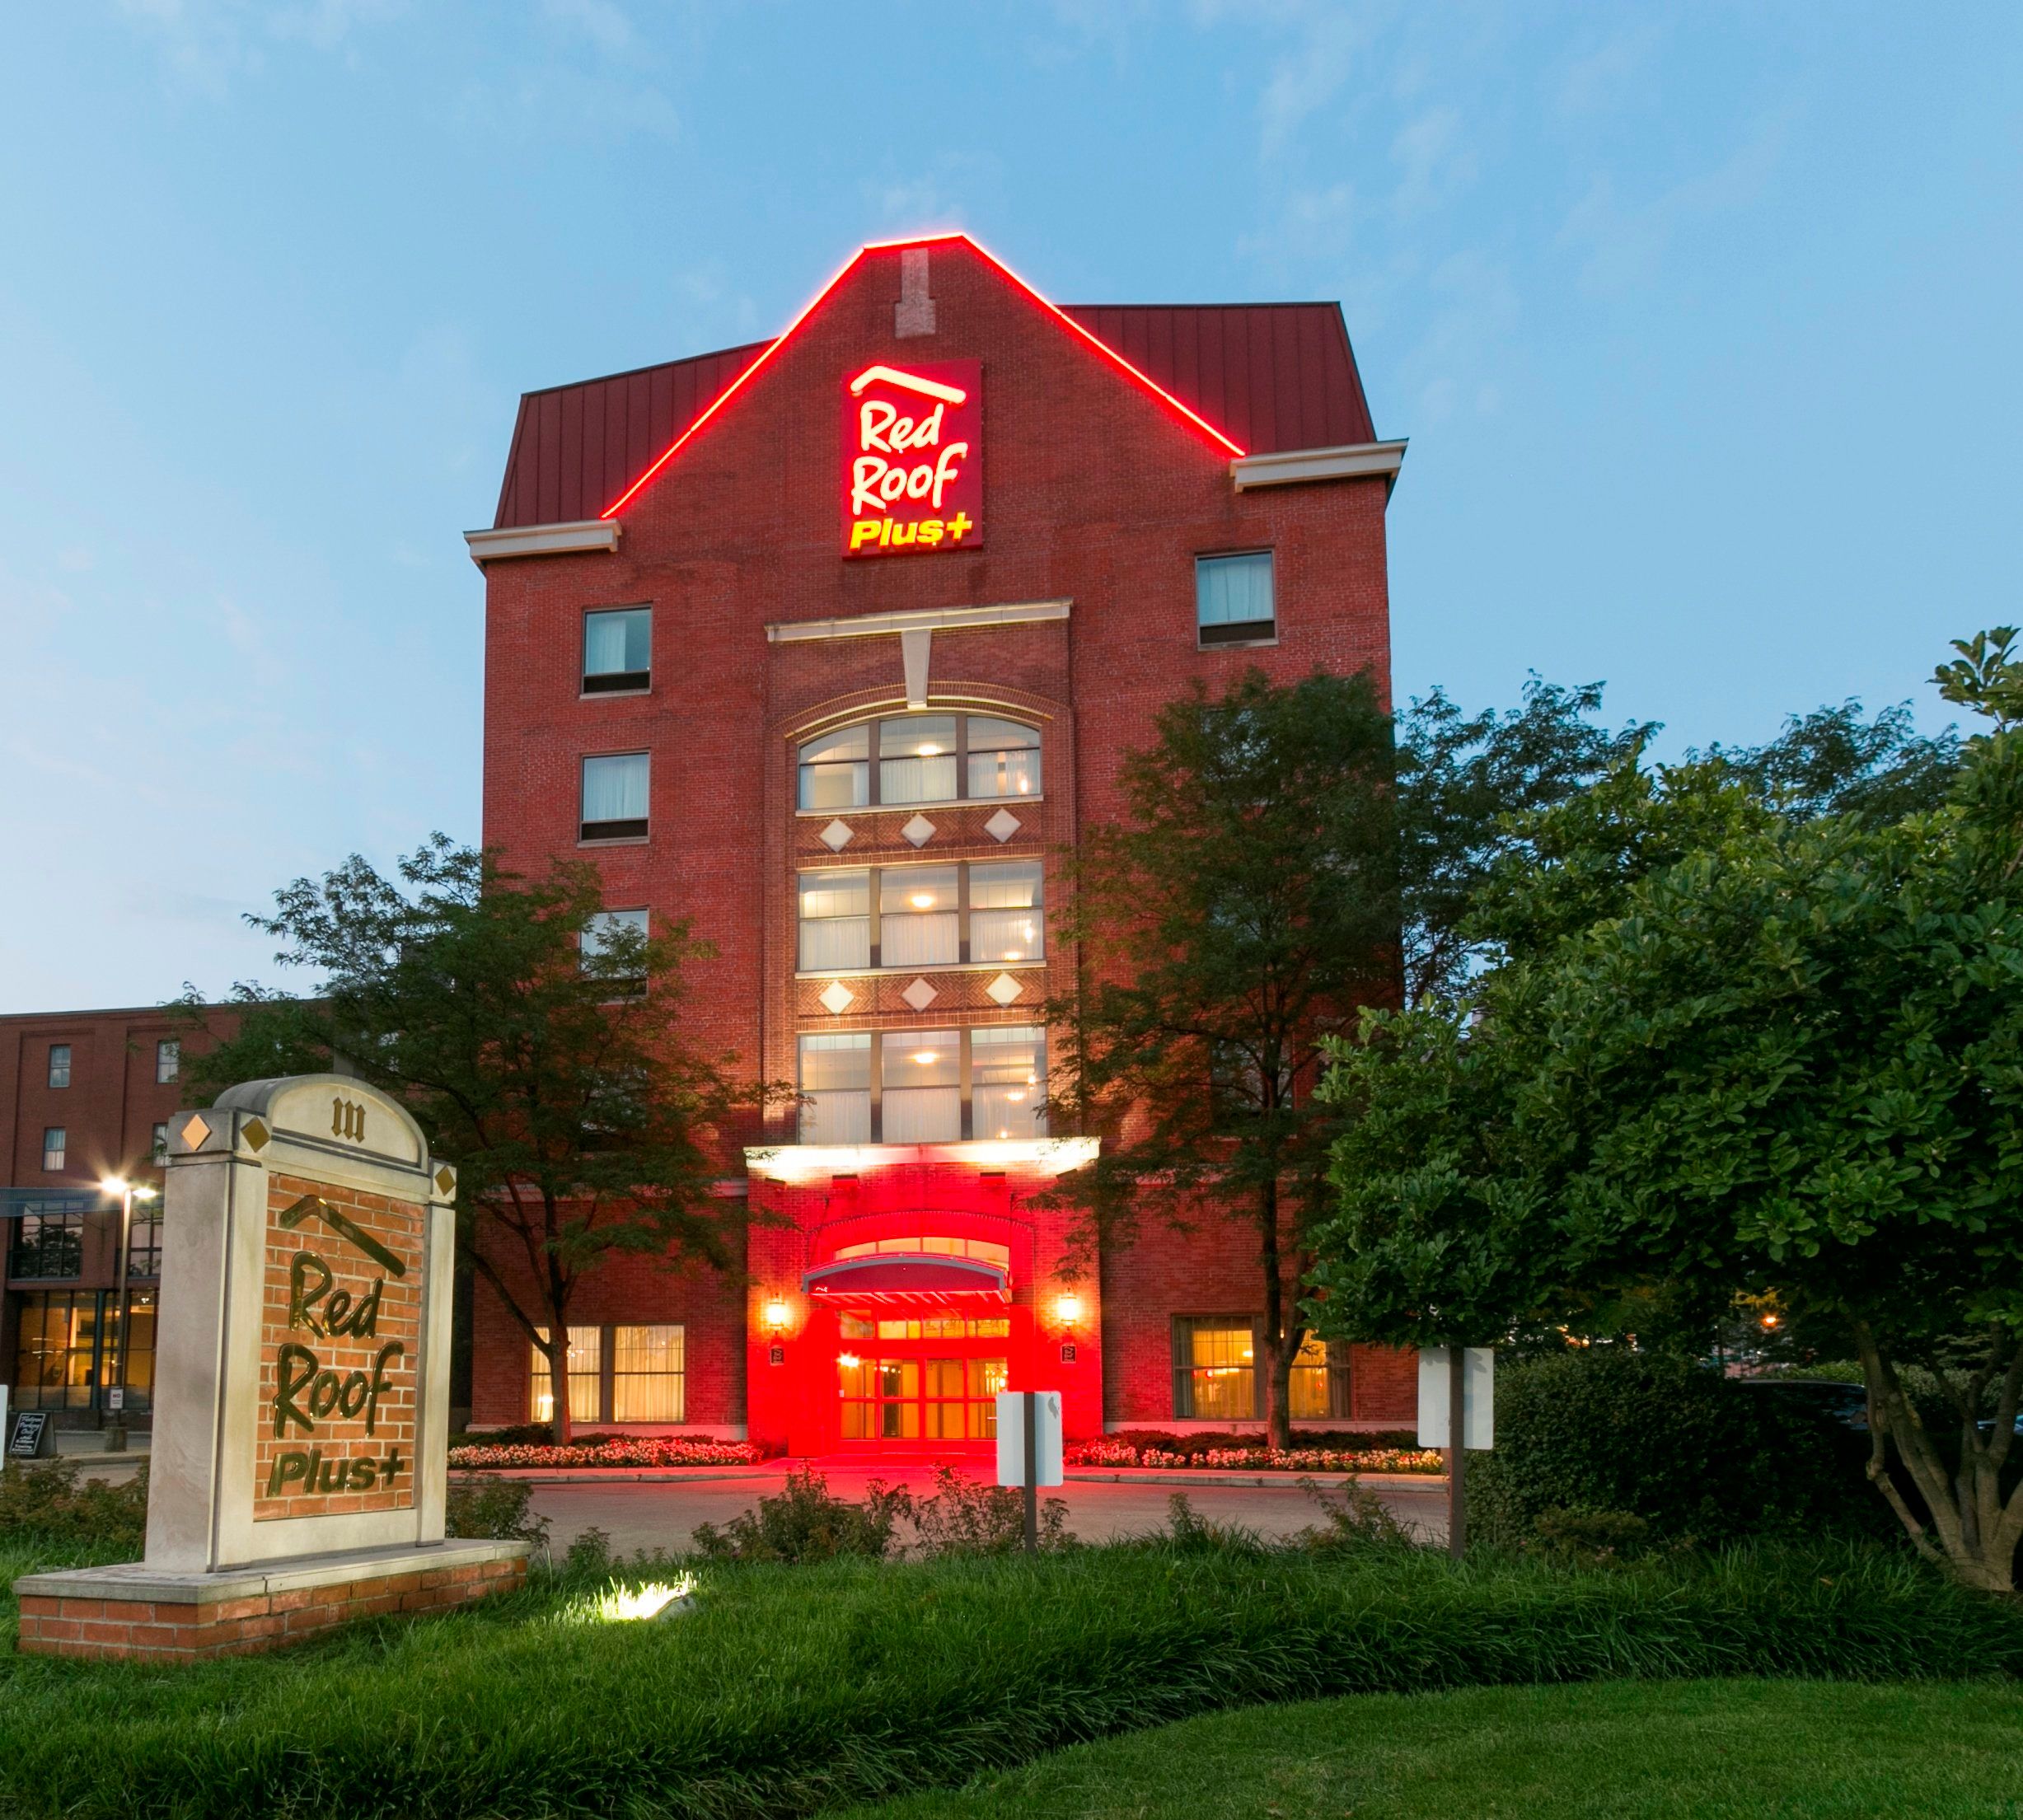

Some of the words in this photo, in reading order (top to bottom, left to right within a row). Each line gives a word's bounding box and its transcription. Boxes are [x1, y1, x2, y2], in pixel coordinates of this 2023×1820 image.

[860, 400, 944, 452] Red
[851, 442, 968, 515] Roof
[850, 512, 972, 550] Plus+
[289, 1251, 383, 1340] Red
[273, 1340, 404, 1439] Roof
[266, 1447, 405, 1498] Plus+
